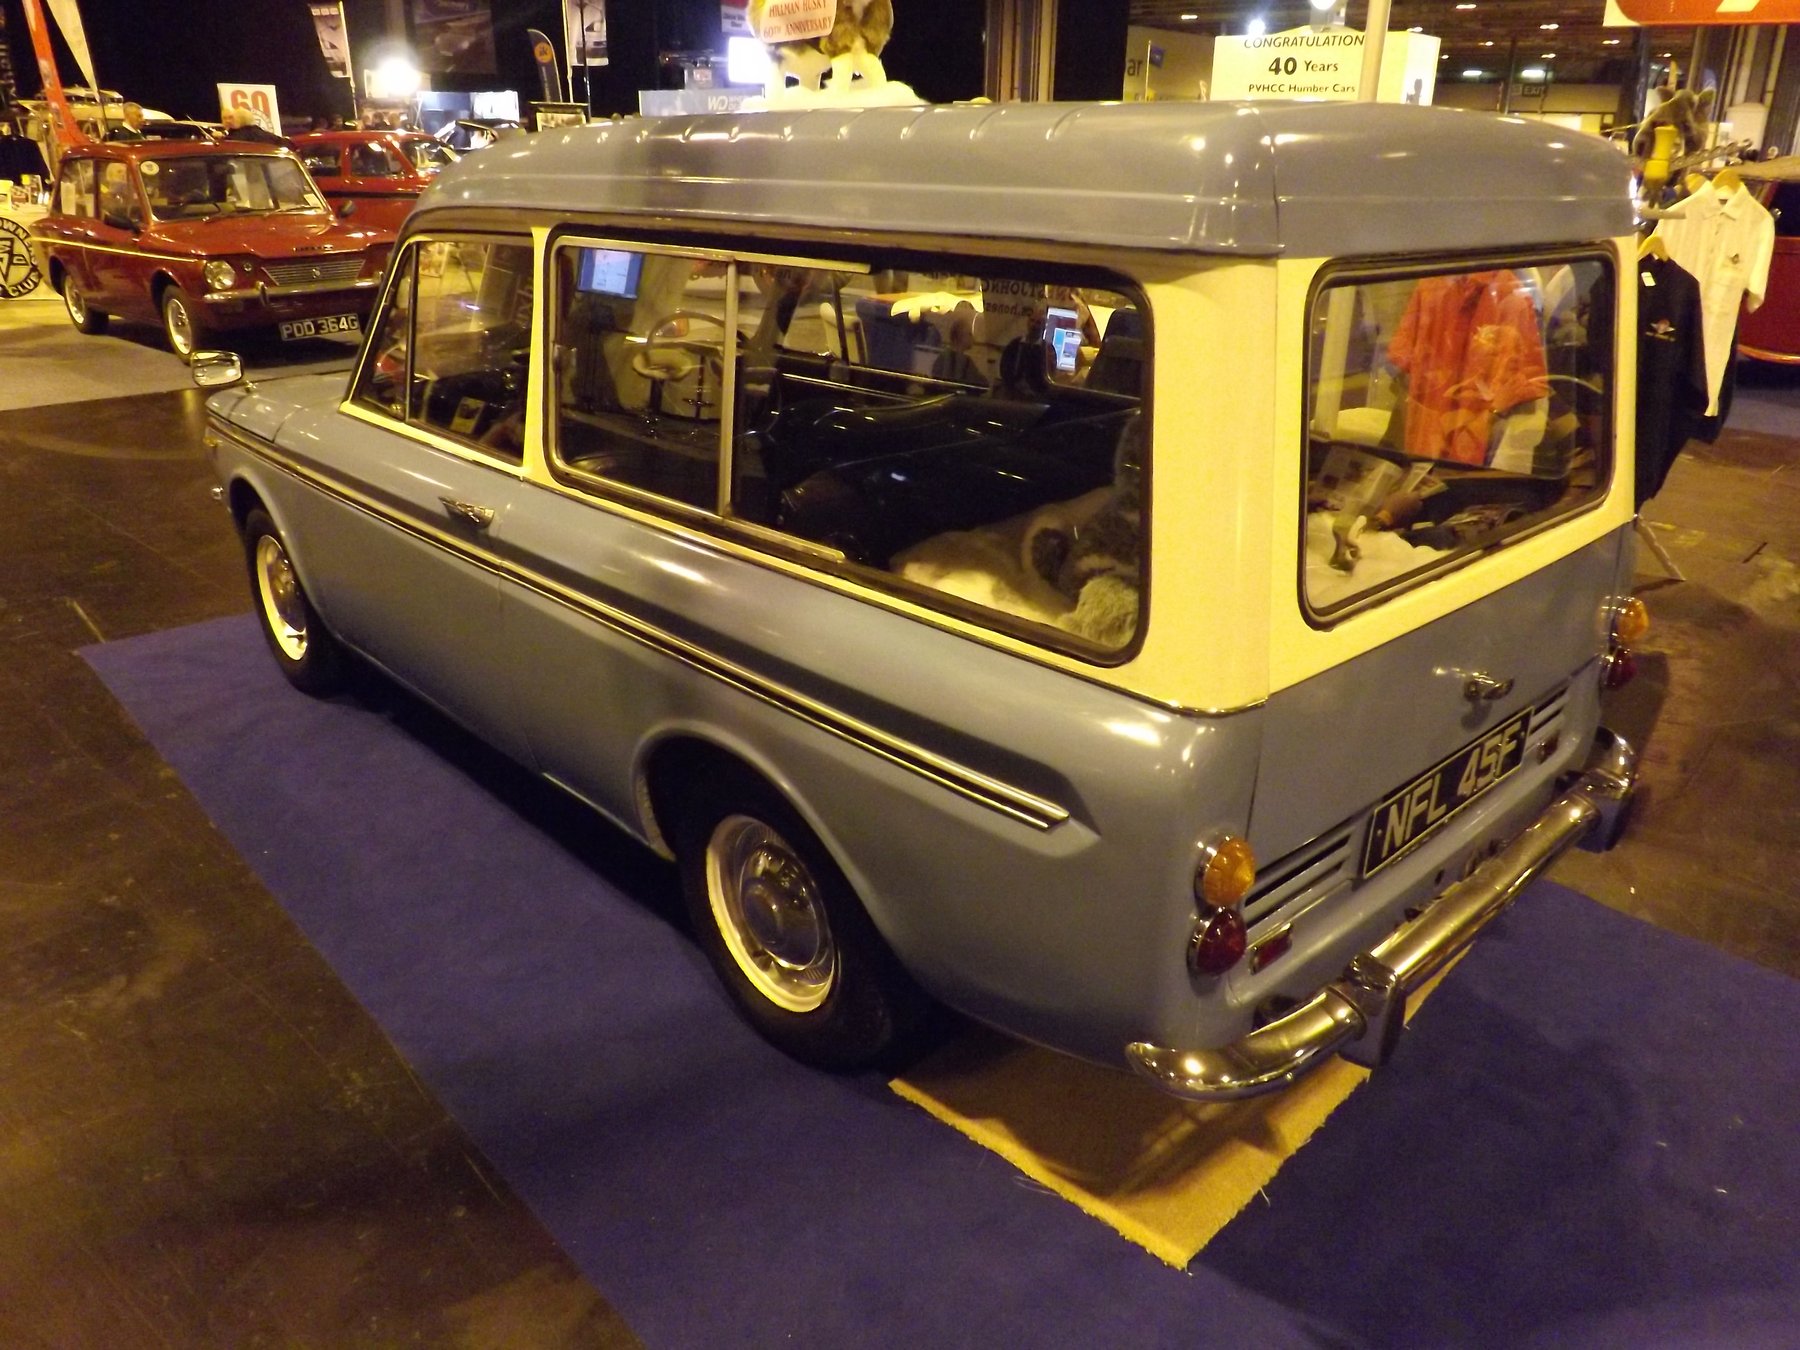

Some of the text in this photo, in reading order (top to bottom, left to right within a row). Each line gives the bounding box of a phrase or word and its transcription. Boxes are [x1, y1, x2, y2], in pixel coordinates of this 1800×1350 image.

[769, 2, 800, 17] HILLMAN
[785, 16, 833, 36] ANNIVERSARY
[1244, 34, 1366, 49] CONGRATULATION
[1268, 57, 1340, 76] 40 Years
[1248, 83, 1356, 93] PVHCC Humber Cars
[230, 90, 271, 118] 60
[317, 315, 359, 334] 364G
[1381, 720, 1522, 859] NFL 45F
